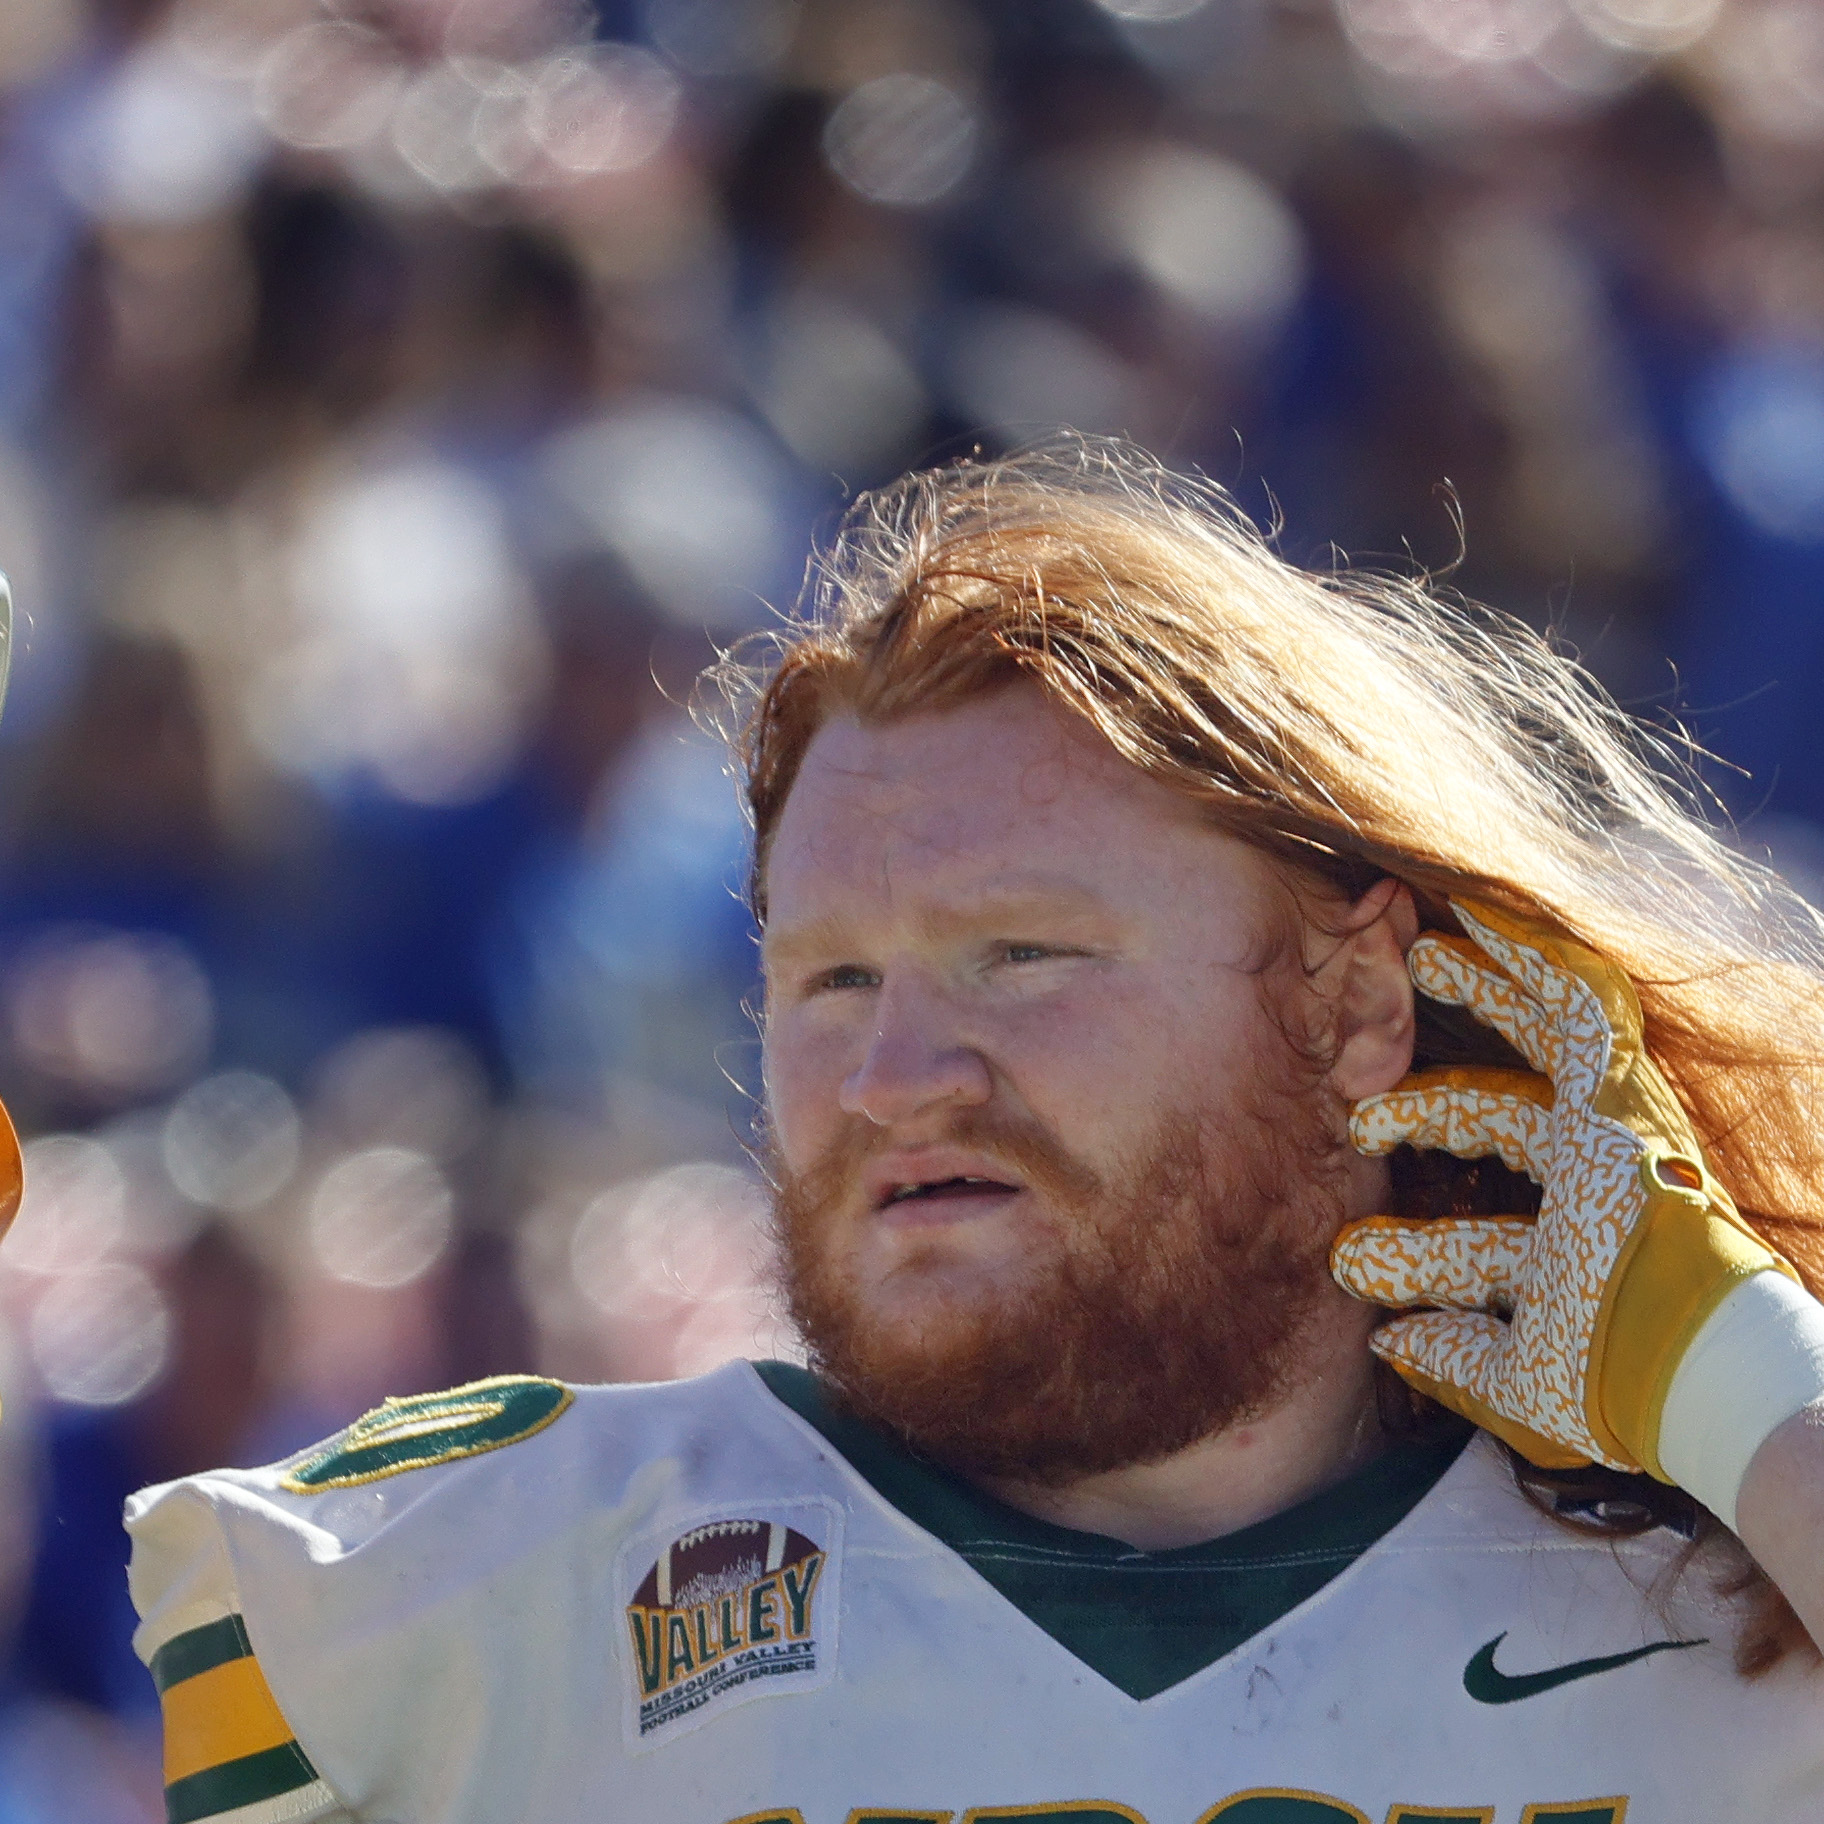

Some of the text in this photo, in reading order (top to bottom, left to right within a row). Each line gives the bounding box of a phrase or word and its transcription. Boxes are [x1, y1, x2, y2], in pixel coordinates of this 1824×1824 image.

[627, 1551, 828, 1701] VALLEY
[639, 1639, 817, 1715] MISSOURI VALLEY
[639, 1658, 817, 1736] FOOTBALL CONFERENCE
